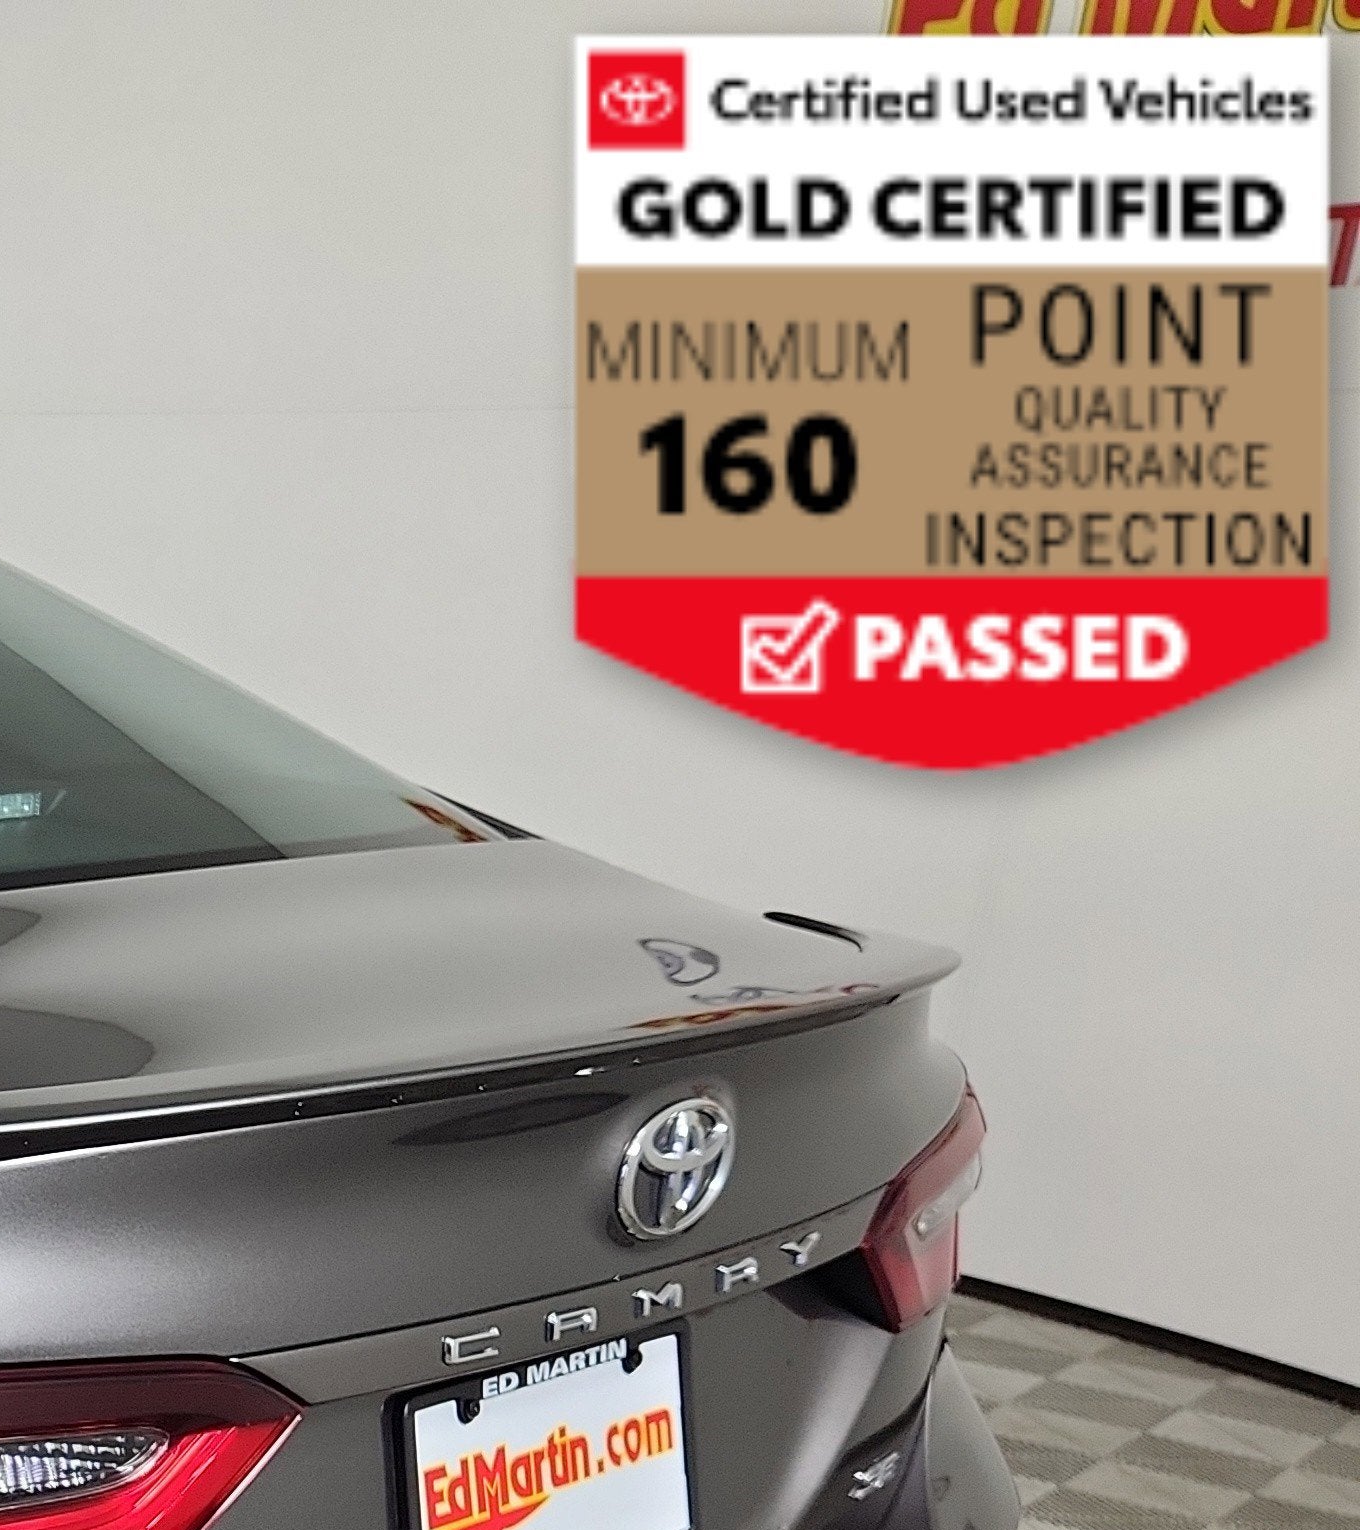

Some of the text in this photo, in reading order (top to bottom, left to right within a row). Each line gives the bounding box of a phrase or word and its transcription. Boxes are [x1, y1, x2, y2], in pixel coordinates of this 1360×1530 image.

[441, 1230, 821, 1366] CAMRY
[481, 1337, 628, 1400] ED MARTIN
